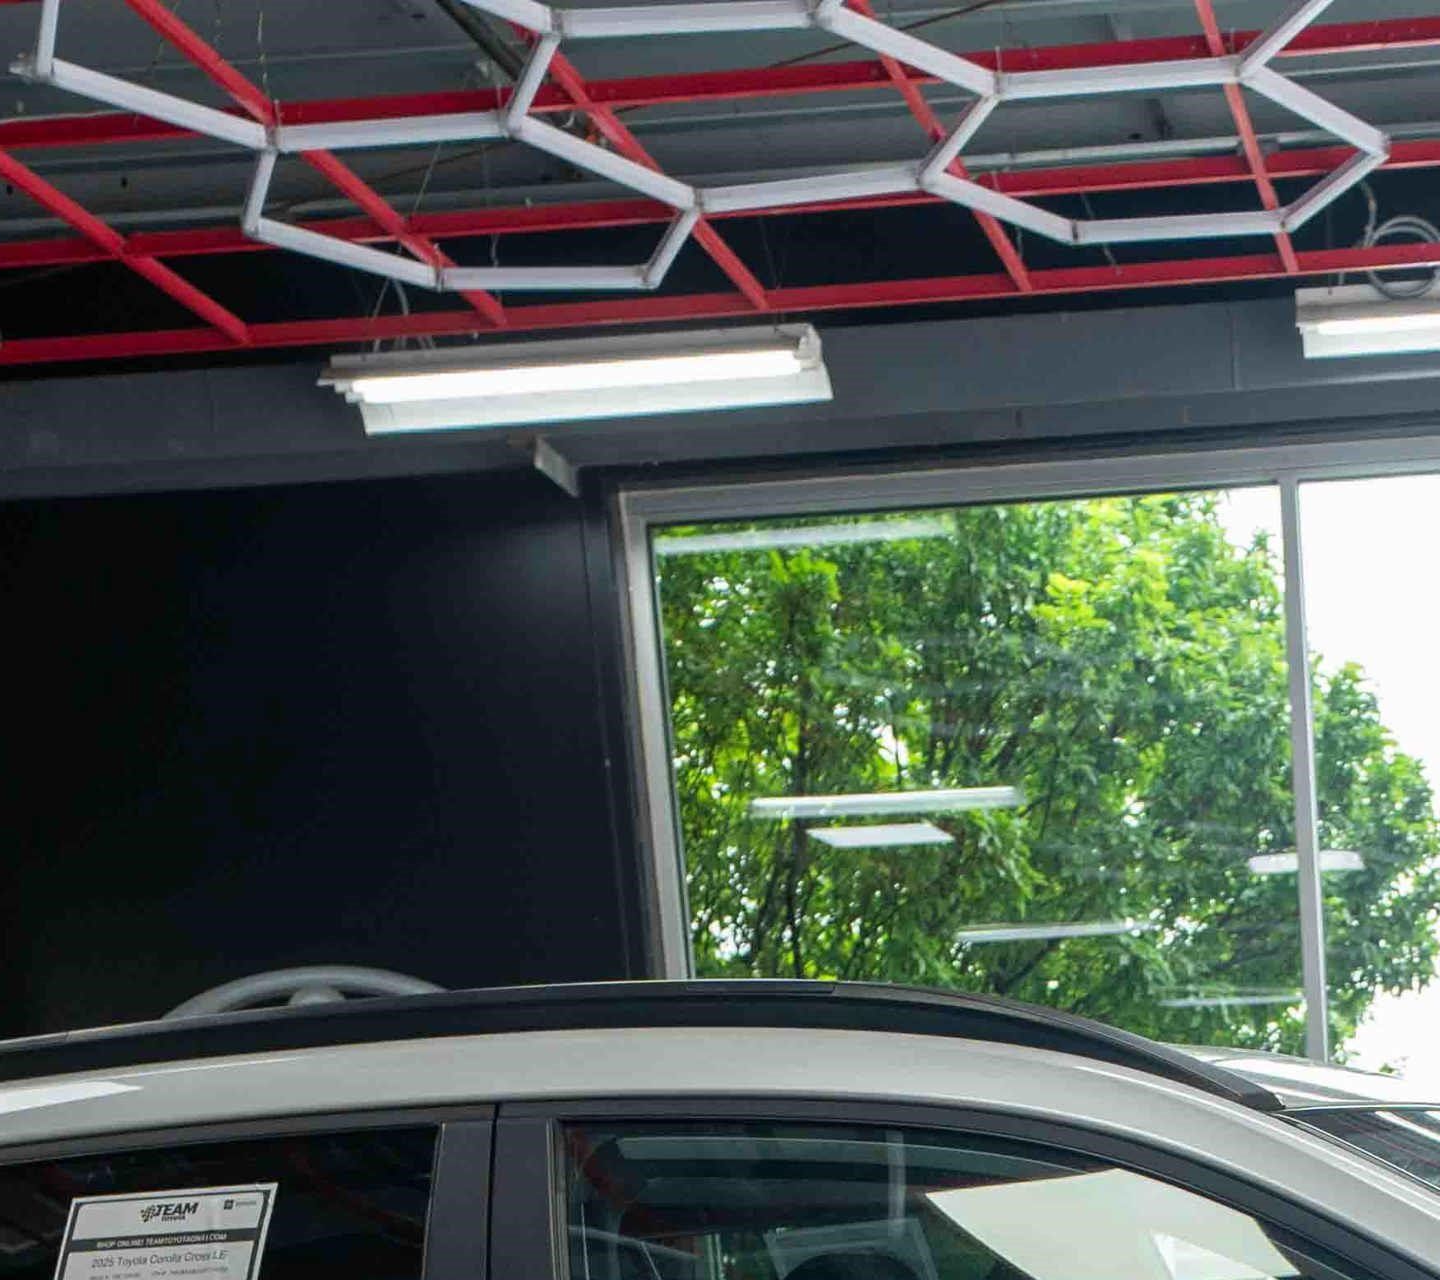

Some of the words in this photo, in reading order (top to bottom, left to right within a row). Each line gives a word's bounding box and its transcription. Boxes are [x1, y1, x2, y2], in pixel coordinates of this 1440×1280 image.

[153, 1202, 199, 1216] TEAM
[118, 1256, 148, 1268] Toyota
[150, 1253, 182, 1265] Corolla
[184, 1251, 211, 1262] Cross
